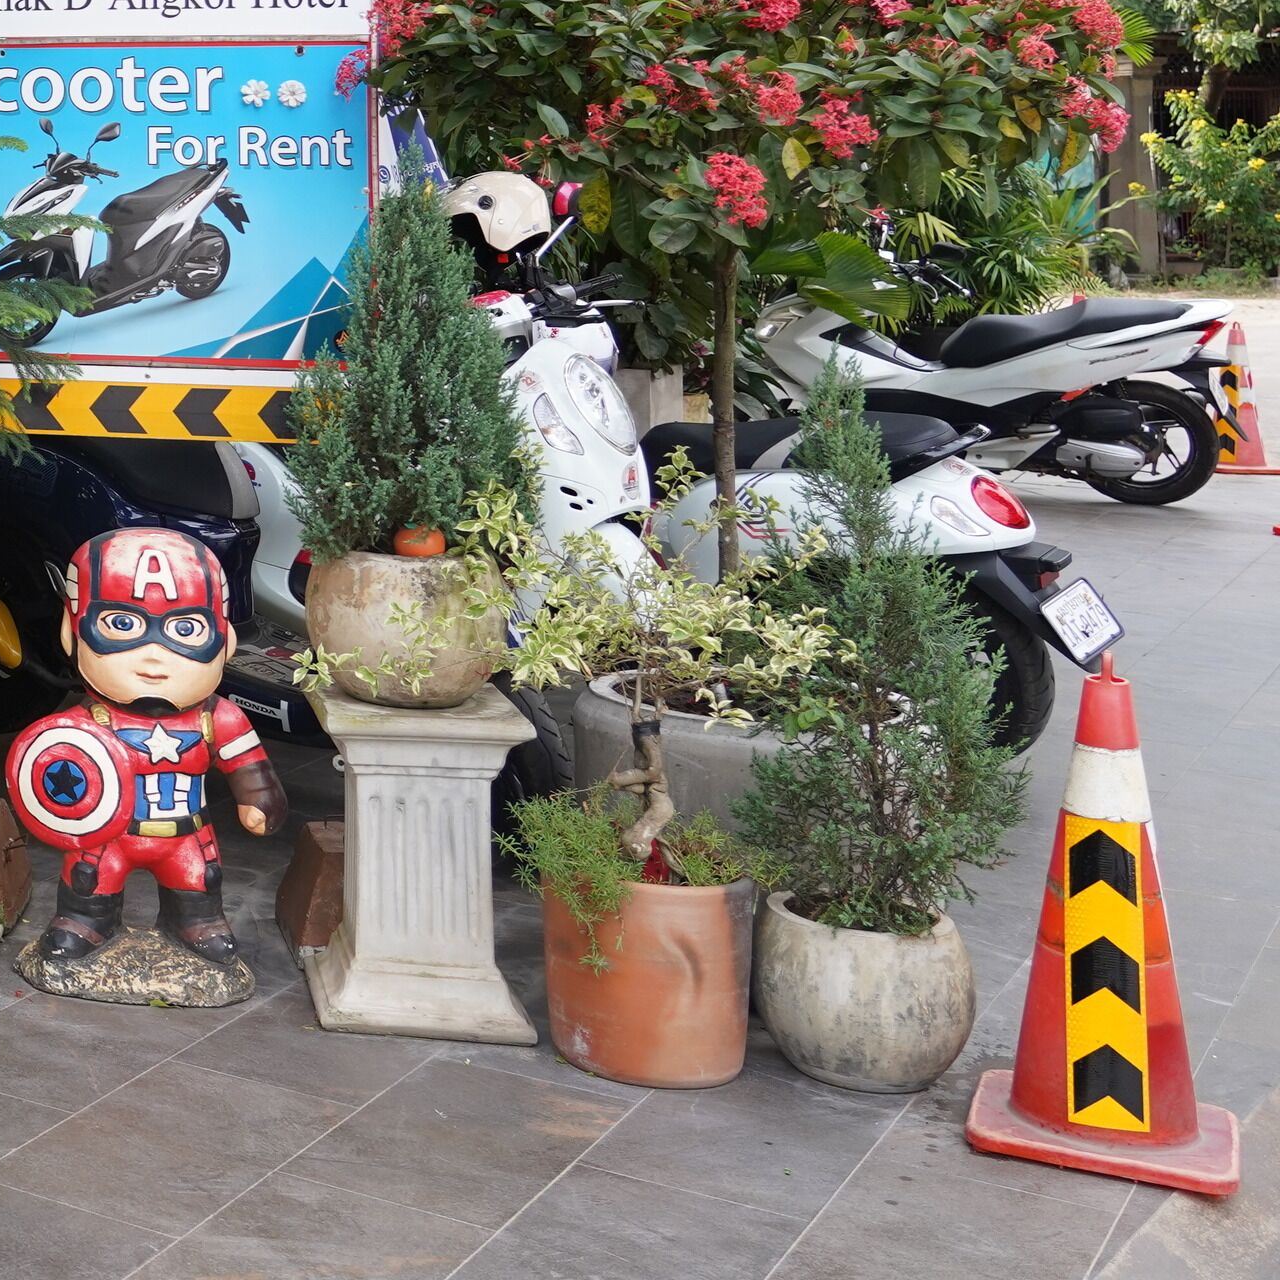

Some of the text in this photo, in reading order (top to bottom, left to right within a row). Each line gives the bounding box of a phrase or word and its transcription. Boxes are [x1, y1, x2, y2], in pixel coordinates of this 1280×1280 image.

[146, 124, 353, 168] For Rent
[234, 696, 278, 717] HONDA
